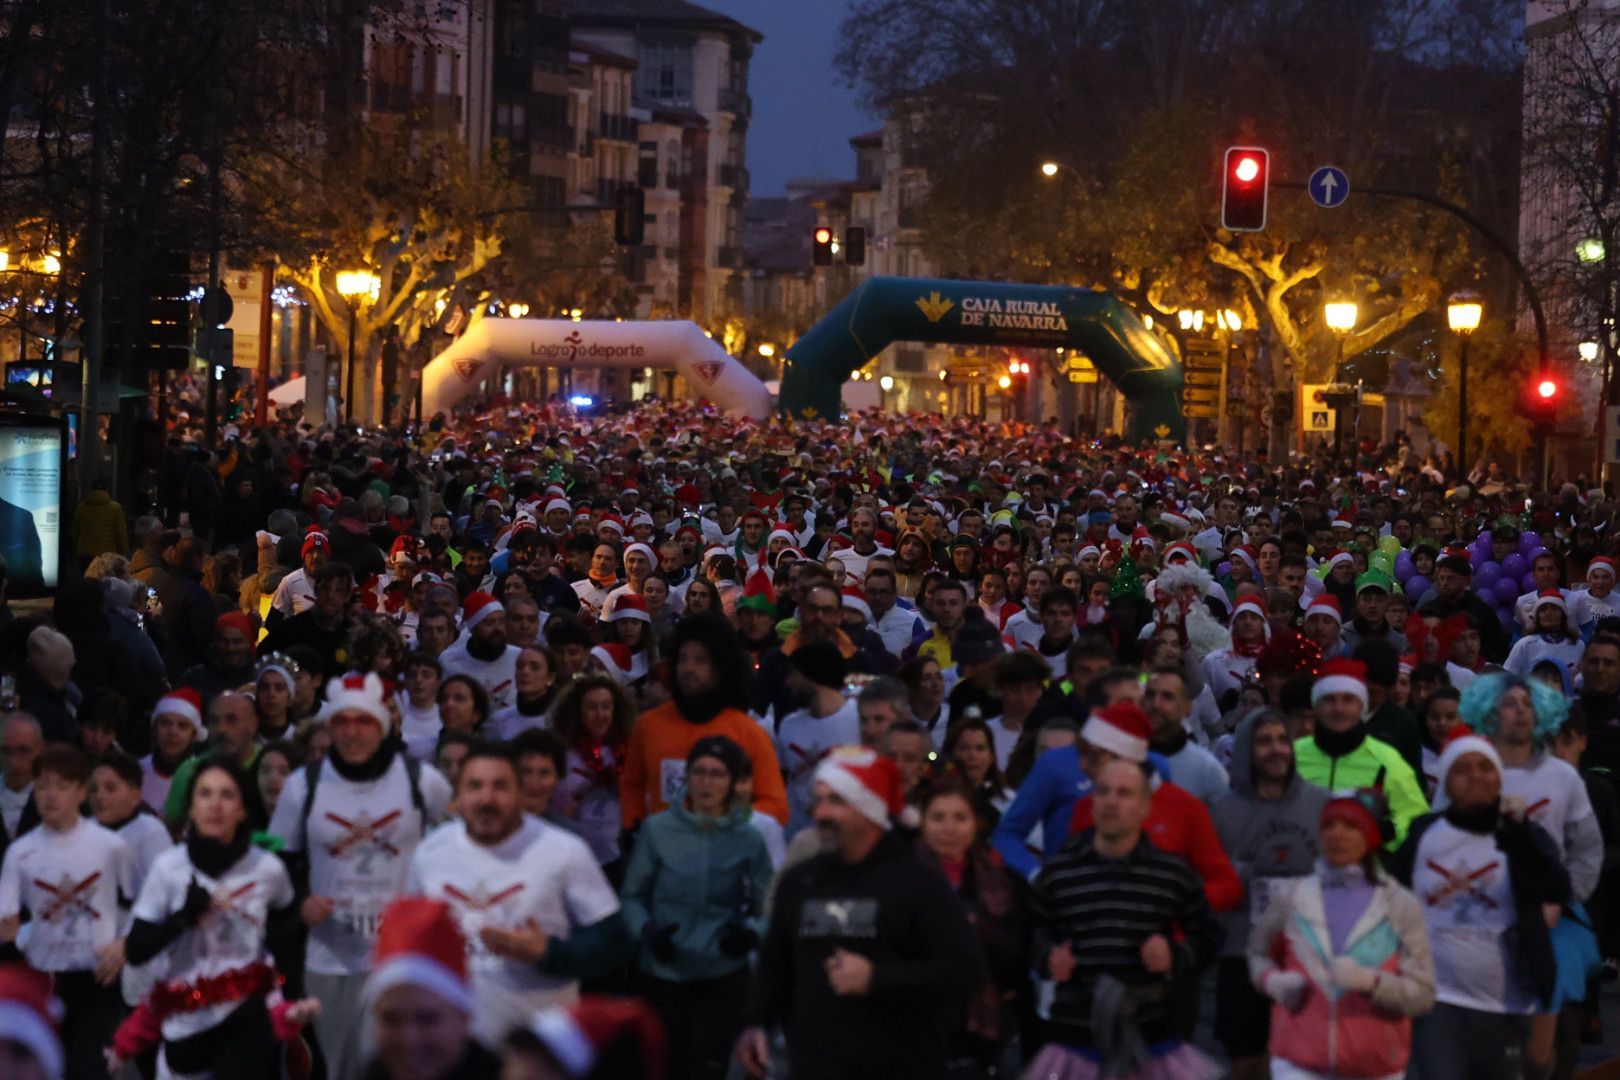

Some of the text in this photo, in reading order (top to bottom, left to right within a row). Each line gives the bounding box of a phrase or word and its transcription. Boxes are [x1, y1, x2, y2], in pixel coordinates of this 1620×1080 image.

[961, 297, 1061, 316] CAJA RURAL
[961, 312, 1068, 331] DE NAVARRA
[588, 342, 644, 359] deporte
